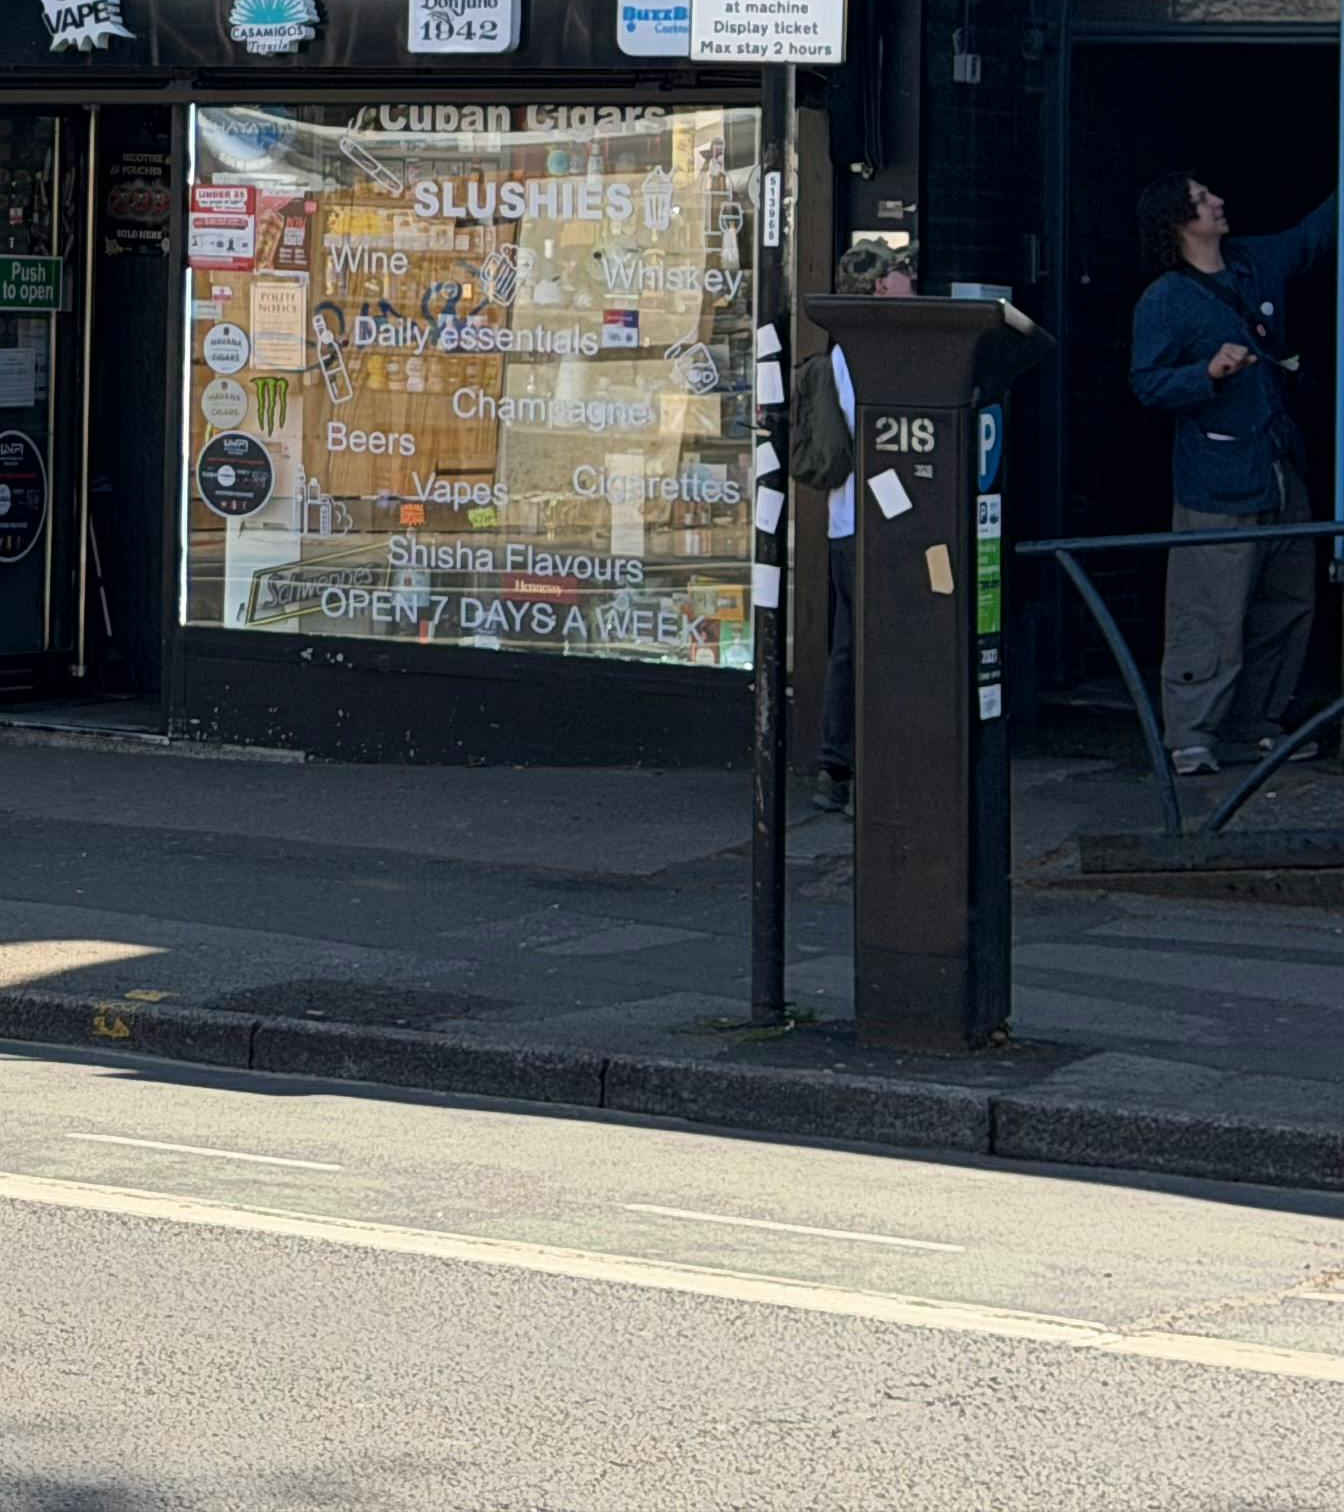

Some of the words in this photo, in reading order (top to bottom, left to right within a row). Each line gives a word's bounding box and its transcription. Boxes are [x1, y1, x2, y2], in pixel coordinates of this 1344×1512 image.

[725, 3, 740, 13] at
[745, 2, 809, 14] machine
[232, 25, 303, 39] CASAMIGOS
[420, 20, 499, 41] 1942
[713, 21, 768, 36] Display
[774, 22, 818, 35] ticket
[700, 41, 732, 53] Max
[737, 41, 768, 56] stay
[773, 41, 784, 55] 2
[789, 42, 832, 56] hours
[379, 104, 511, 132] Cuban
[526, 104, 667, 138] Cigars
[414, 181, 633, 221] SLUSHIES
[12, 261, 46, 282] Push
[330, 245, 408, 275] Wine
[602, 252, 744, 302] Whiskey
[2, 280, 16, 300] to
[20, 284, 54, 305] open
[354, 314, 430, 355] Daily
[439, 323, 600, 355] essentials
[453, 387, 652, 431] Champagne
[326, 421, 416, 456] Beers
[876, 416, 935, 452] 218
[979, 413, 996, 476] P
[413, 471, 509, 510] Vapes
[572, 464, 741, 505] Cigarettes
[387, 534, 494, 572] Shisha
[506, 543, 645, 583] Flavours
[263, 564, 374, 610] Schweppes
[514, 579, 563, 597] Hennessy
[320, 588, 419, 624] OPEN
[429, 596, 449, 626] 7
[460, 597, 557, 634] DAYS
[561, 605, 588, 639] A
[596, 607, 705, 645] WEEK
